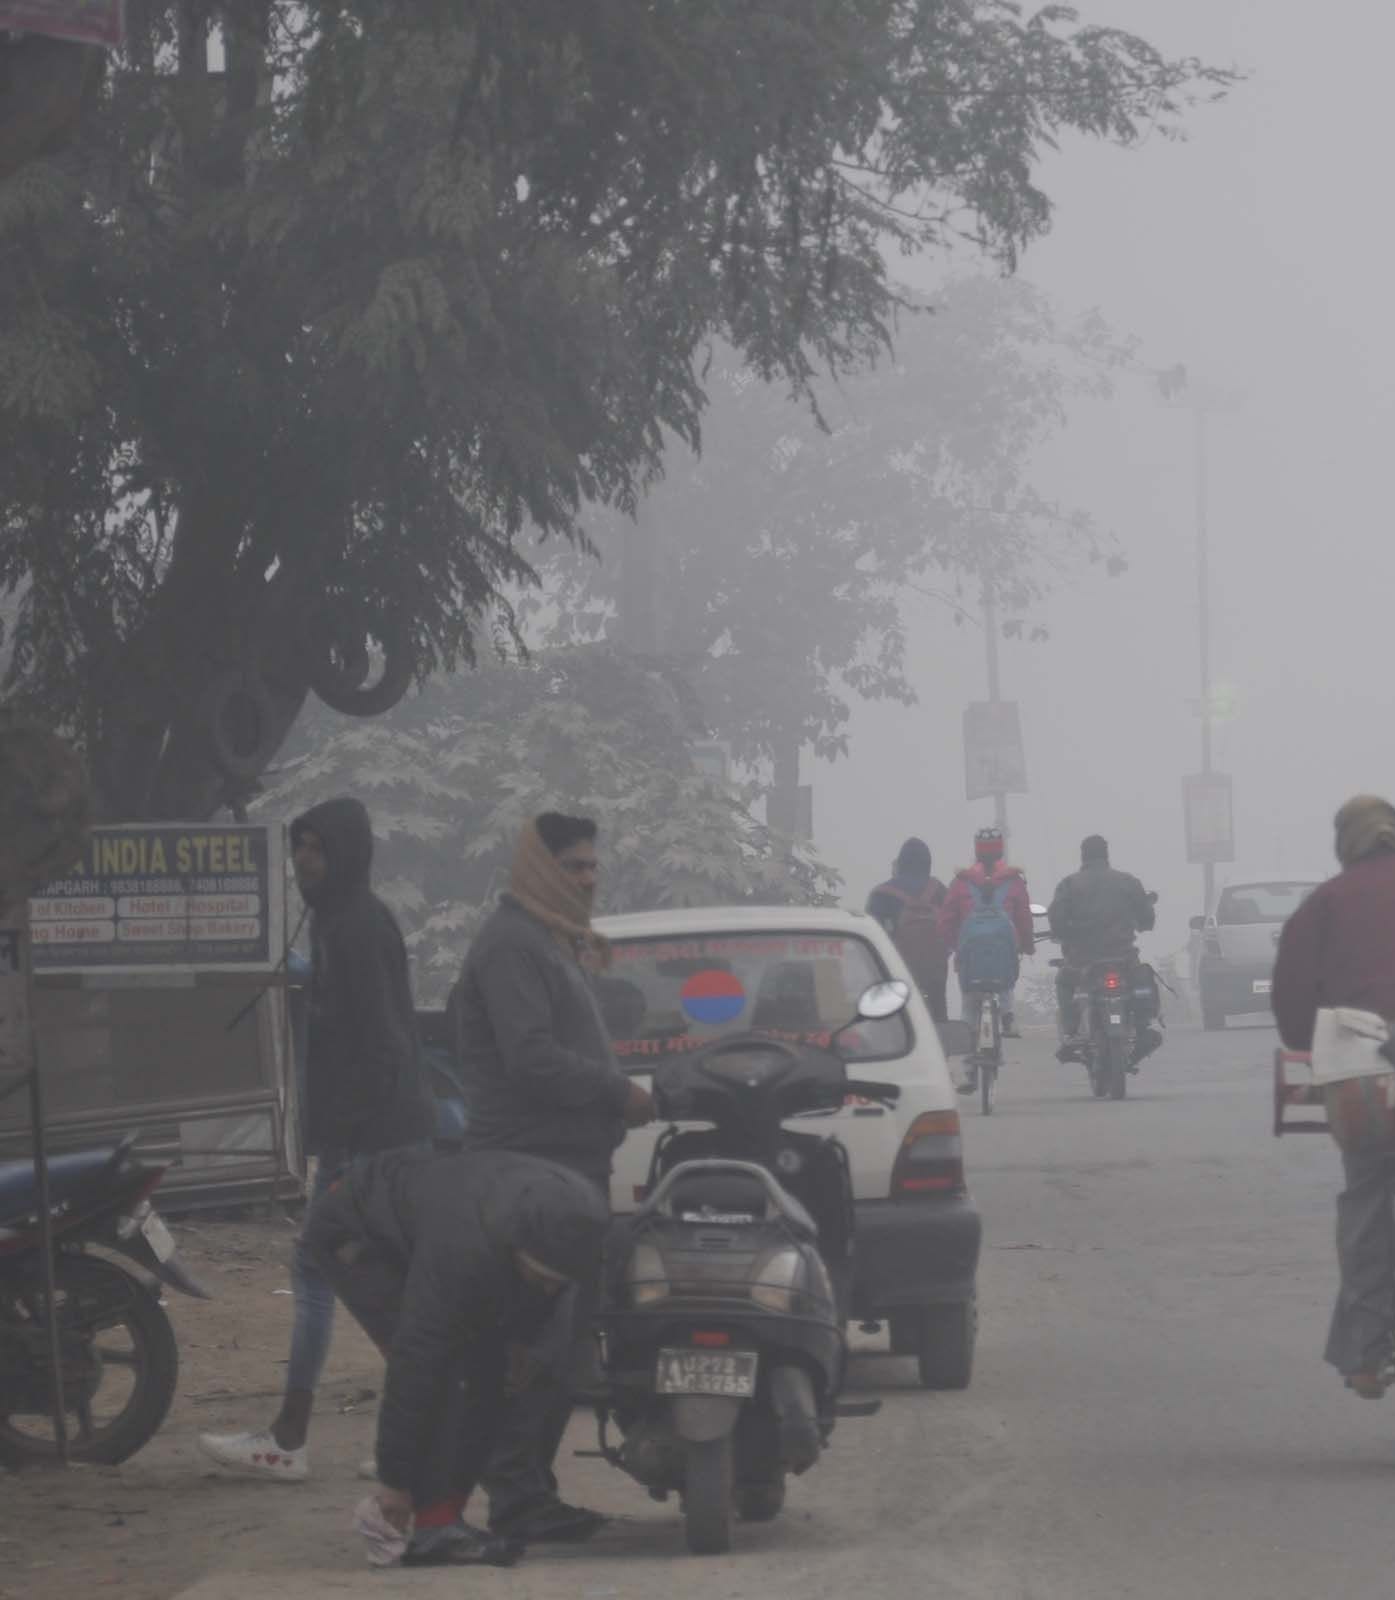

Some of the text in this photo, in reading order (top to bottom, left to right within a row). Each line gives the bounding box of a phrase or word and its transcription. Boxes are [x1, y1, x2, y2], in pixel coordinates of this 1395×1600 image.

[92, 837, 168, 875] INDIA
[176, 835, 258, 873] STEEL
[53, 901, 106, 915] Kitchen
[129, 898, 169, 914] Hotel
[55, 923, 99, 939] Home
